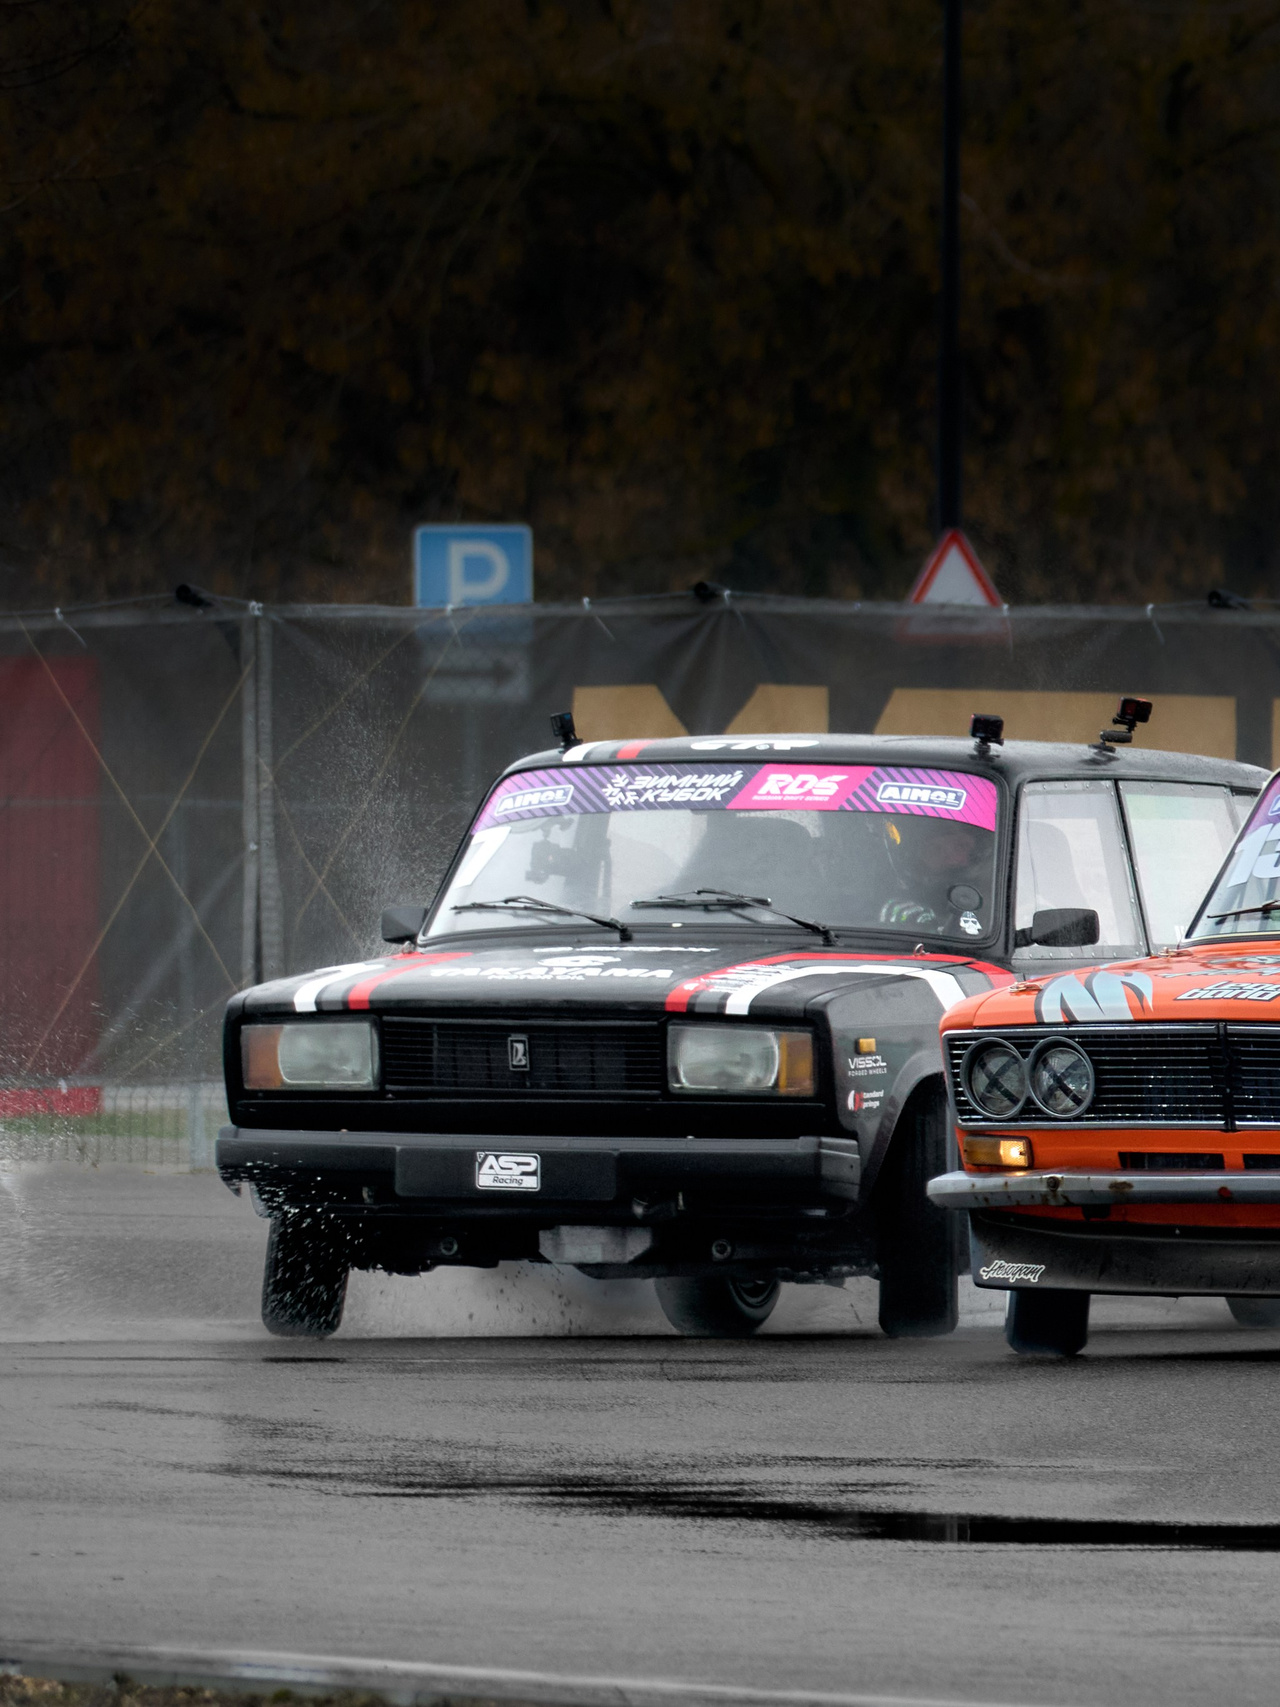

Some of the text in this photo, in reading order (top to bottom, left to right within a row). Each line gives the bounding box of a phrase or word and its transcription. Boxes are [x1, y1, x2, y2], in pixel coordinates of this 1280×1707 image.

[449, 539, 510, 608] P
[632, 770, 744, 788] ЗИМНИЙ
[757, 774, 849, 795] RDS
[499, 788, 568, 811] AIMOL
[640, 787, 733, 801] КУБОК
[881, 786, 960, 806] AIMOL
[430, 967, 674, 979] TAKAYAMA
[479, 1155, 538, 1176] ASP
[493, 1176, 524, 1185] Racing
